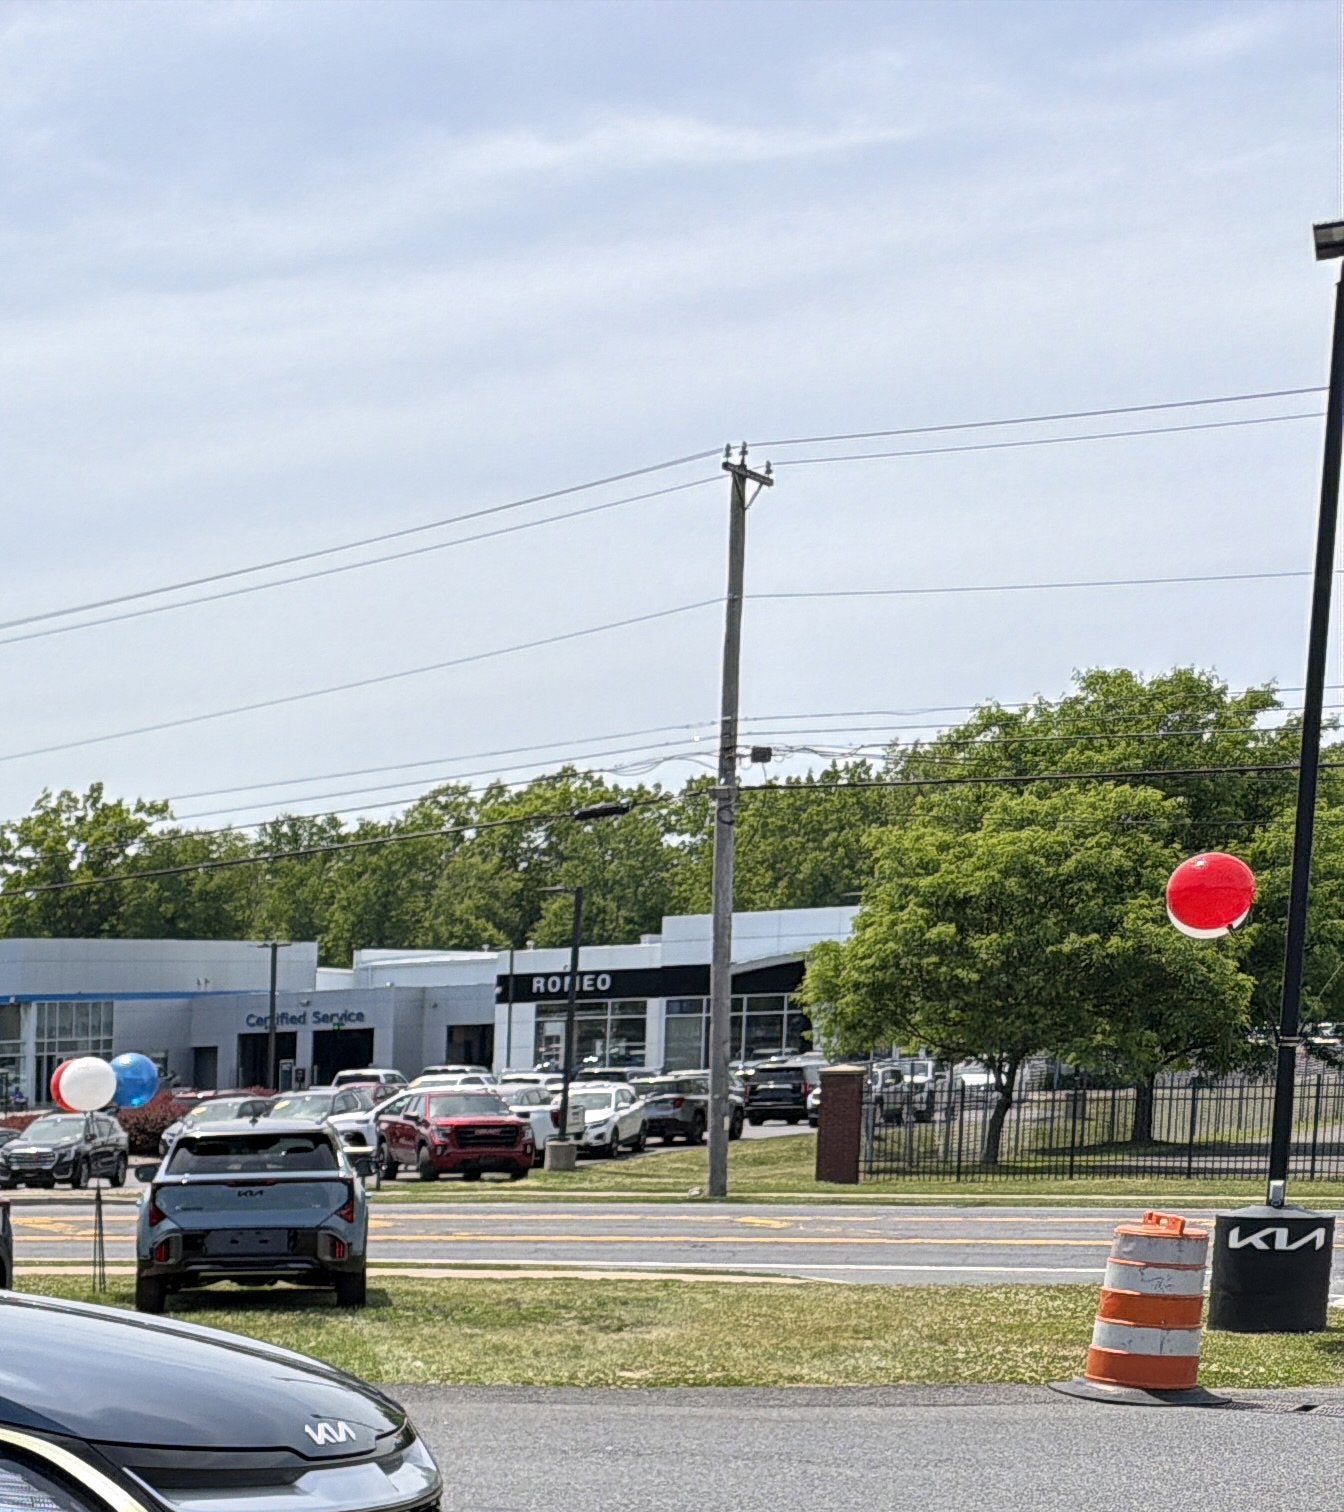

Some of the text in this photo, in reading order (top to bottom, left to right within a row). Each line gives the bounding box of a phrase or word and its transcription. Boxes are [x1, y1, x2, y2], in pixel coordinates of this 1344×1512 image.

[532, 974, 611, 993] ROMEO
[246, 1010, 365, 1027] Cerified Service
[1228, 1226, 1326, 1251] KIA
[304, 1420, 356, 1445] KIA
